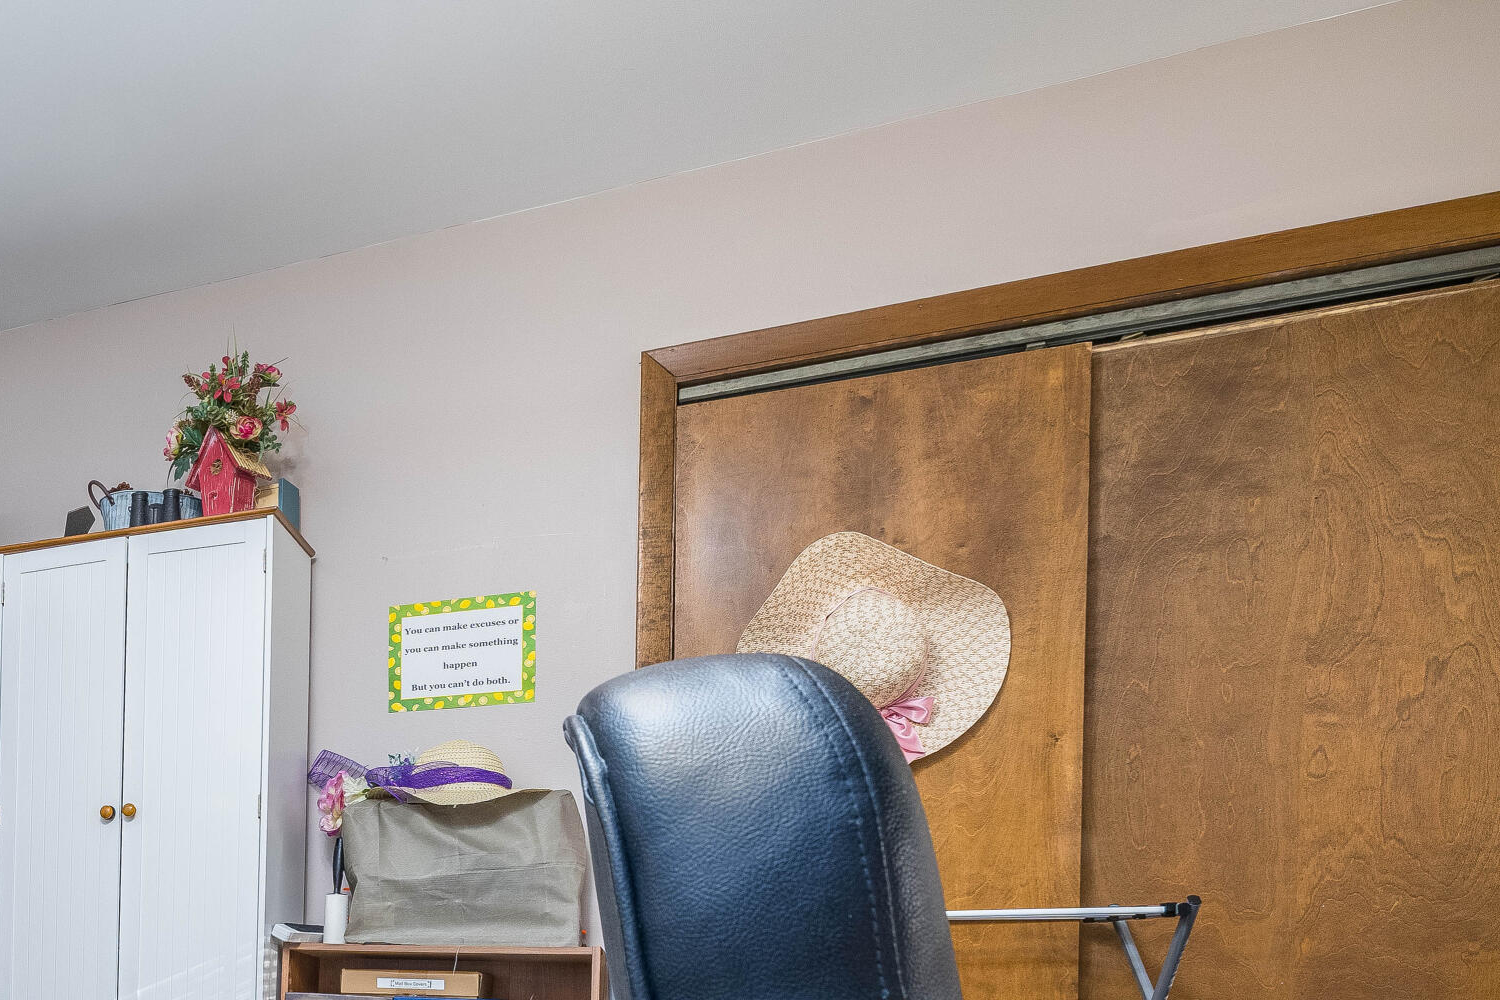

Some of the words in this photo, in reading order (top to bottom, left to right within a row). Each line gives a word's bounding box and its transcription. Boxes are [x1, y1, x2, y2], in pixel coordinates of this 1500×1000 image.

[405, 627, 423, 635] You
[424, 626, 441, 634] can
[442, 622, 468, 631] make
[470, 619, 506, 629] excuses
[508, 618, 519, 626] or
[405, 646, 421, 655] you
[423, 644, 440, 652] can
[441, 641, 467, 651] make
[469, 637, 519, 648] something
[443, 660, 478, 670] happen
[411, 683, 427, 692] But
[428, 682, 446, 691] you
[448, 680, 470, 689] can't
[472, 678, 484, 686] do
[486, 676, 511, 686] both.
